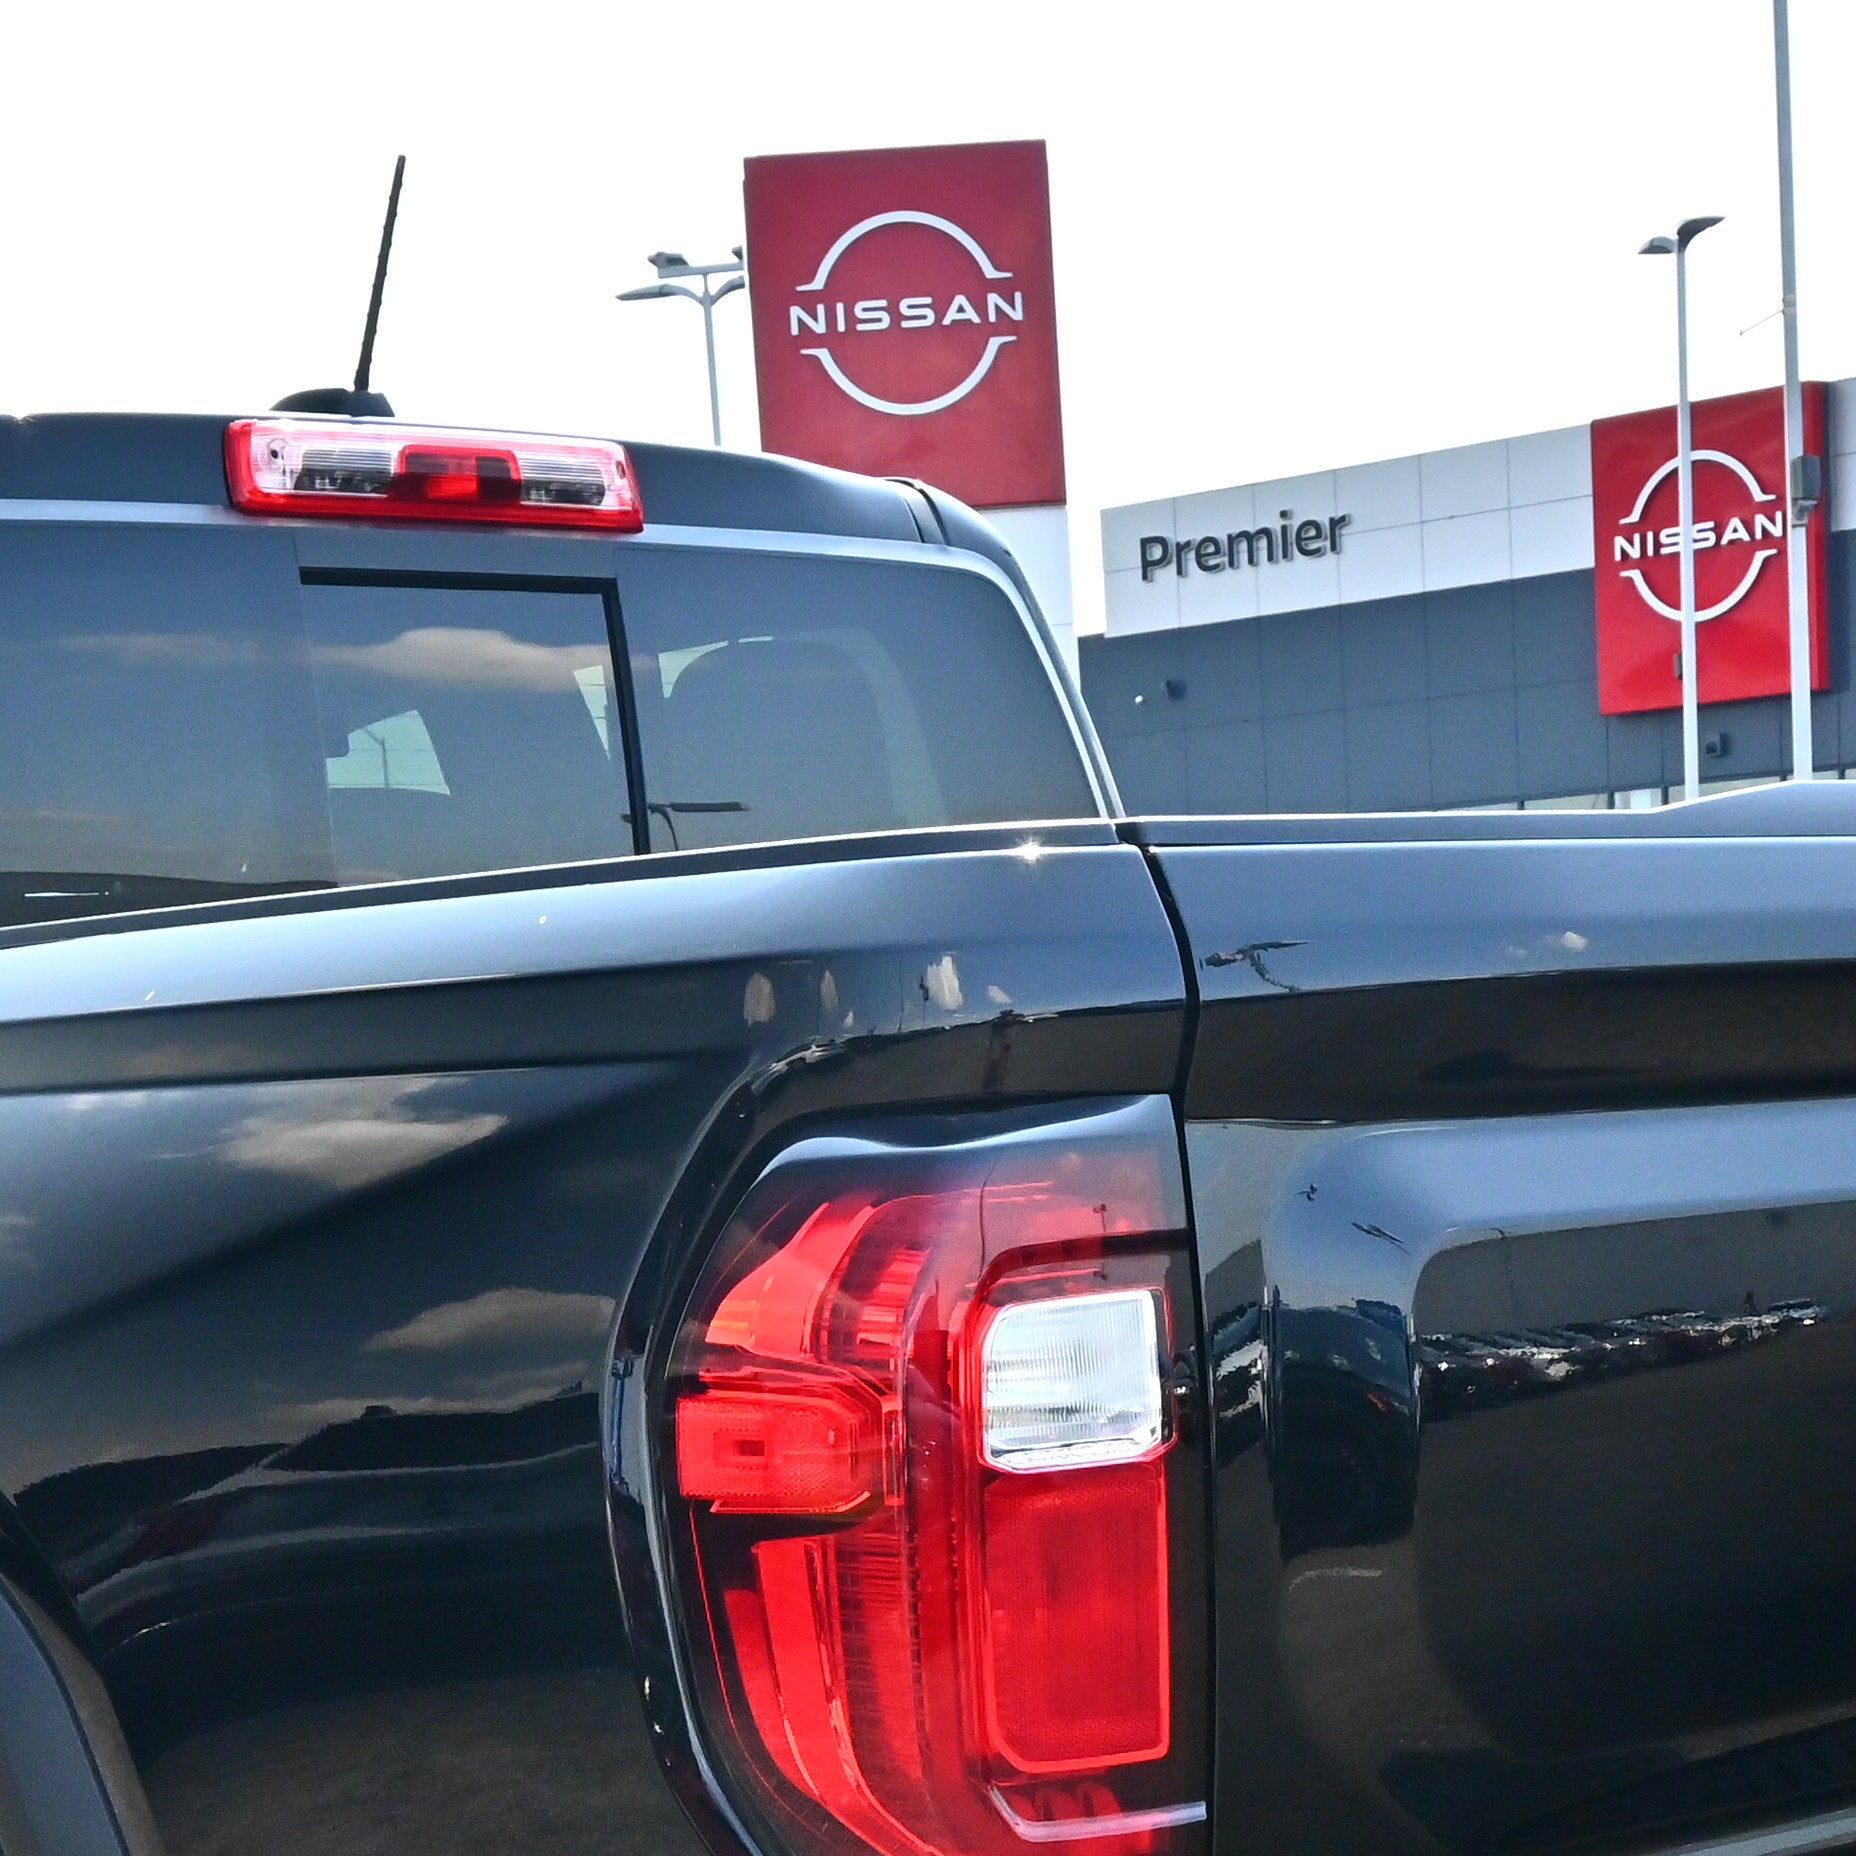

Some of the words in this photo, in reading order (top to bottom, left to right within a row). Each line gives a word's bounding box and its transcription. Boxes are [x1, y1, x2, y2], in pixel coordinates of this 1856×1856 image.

[789, 291, 1024, 336] NISSAN
[1139, 508, 1352, 583] Premier
[1614, 510, 1783, 562] NISSAN
